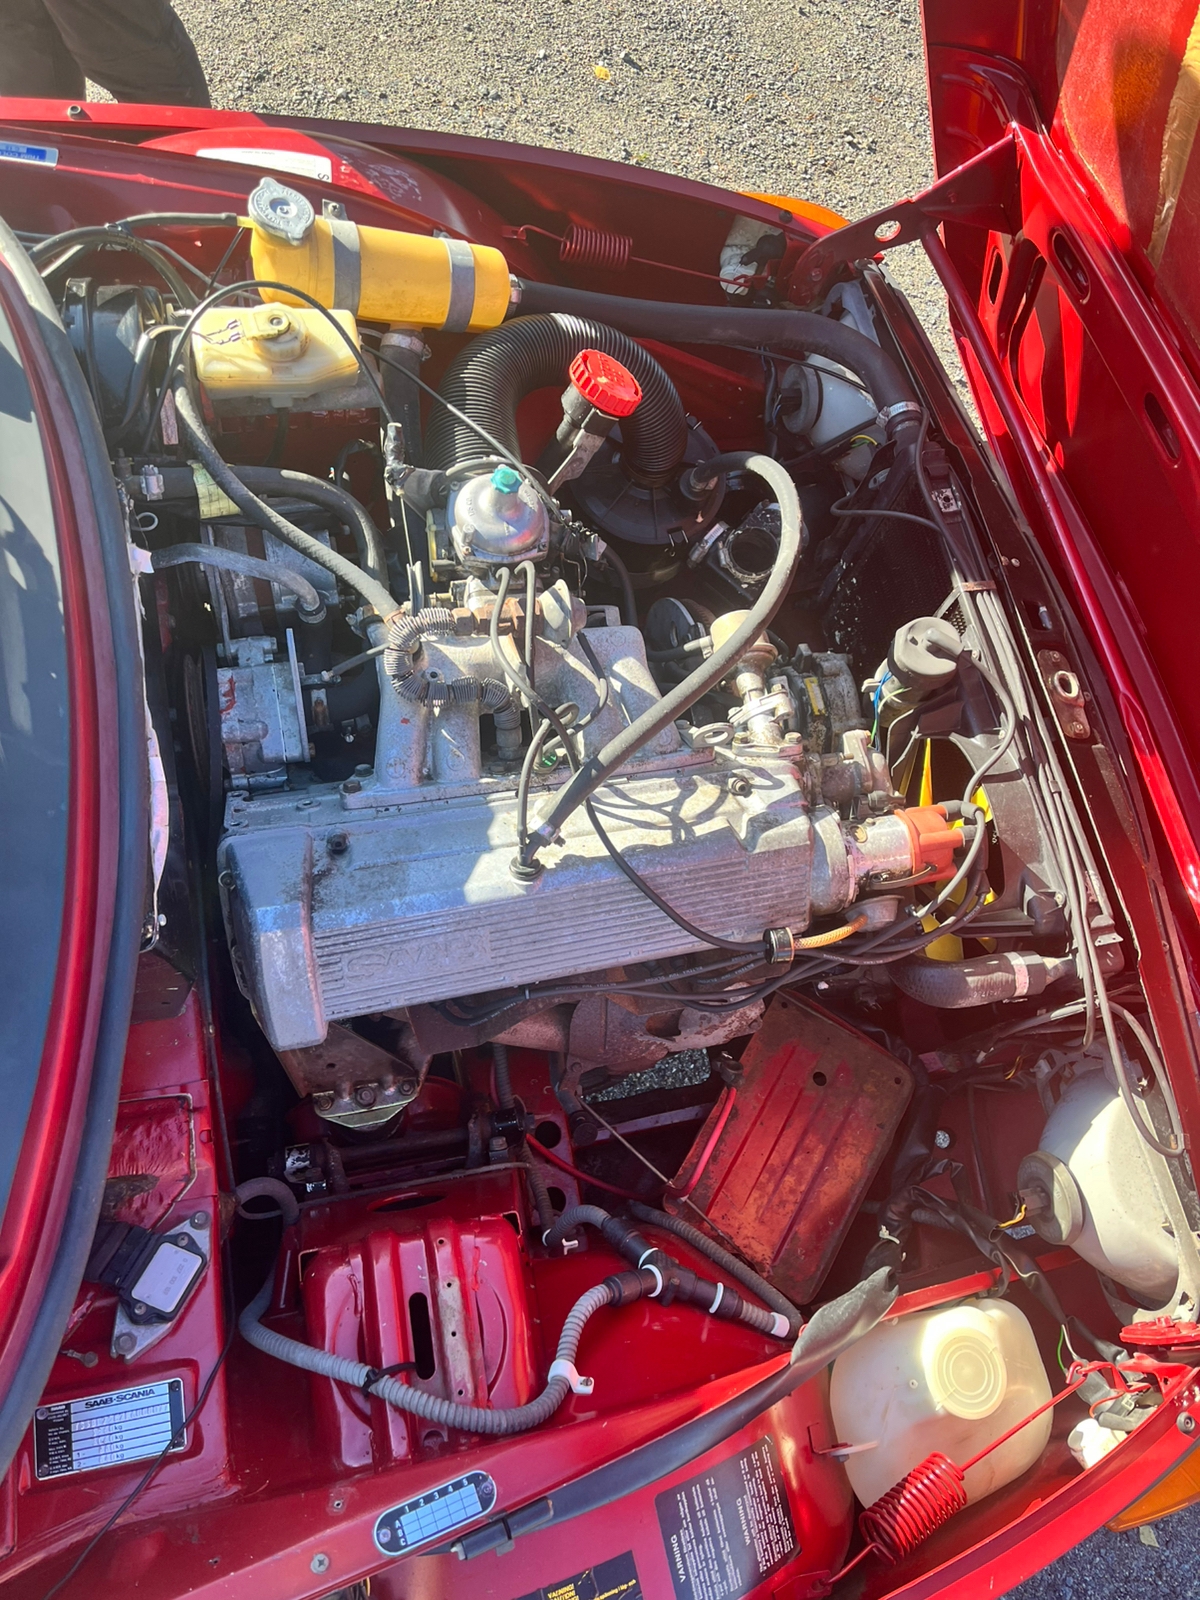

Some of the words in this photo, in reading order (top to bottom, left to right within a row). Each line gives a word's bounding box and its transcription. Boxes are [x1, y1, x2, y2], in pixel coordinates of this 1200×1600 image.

[462, 1478, 468, 1486] 5
[395, 1520, 401, 1528] A
[736, 1498, 751, 1546] WARNING
[398, 1529, 403, 1537] B
[400, 1538, 406, 1546] C
[671, 1534, 687, 1583] VARNING
